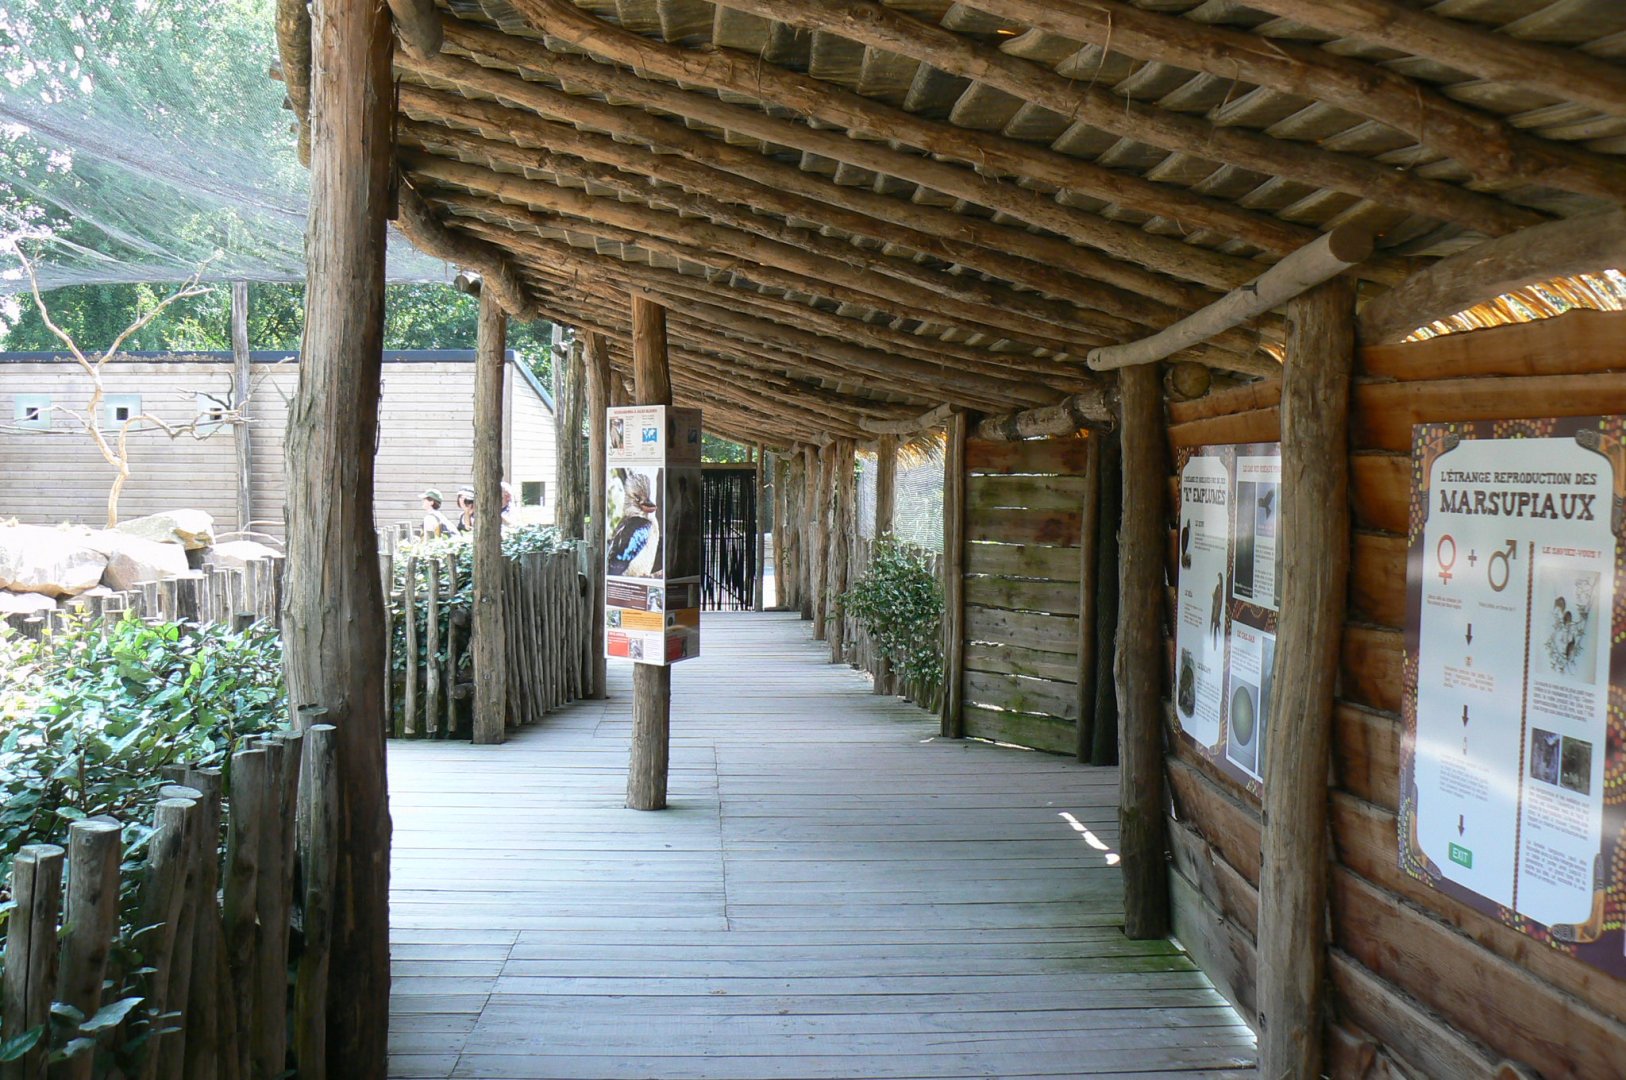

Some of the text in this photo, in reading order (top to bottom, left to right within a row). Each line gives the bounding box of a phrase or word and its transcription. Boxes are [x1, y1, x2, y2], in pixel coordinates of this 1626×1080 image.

[1441, 469, 1597, 485] L'ÉTRANGE REPRODUCTION DES
[1440, 489, 1596, 521] MARSUPIAUX
[1453, 847, 1468, 863] EXIT
